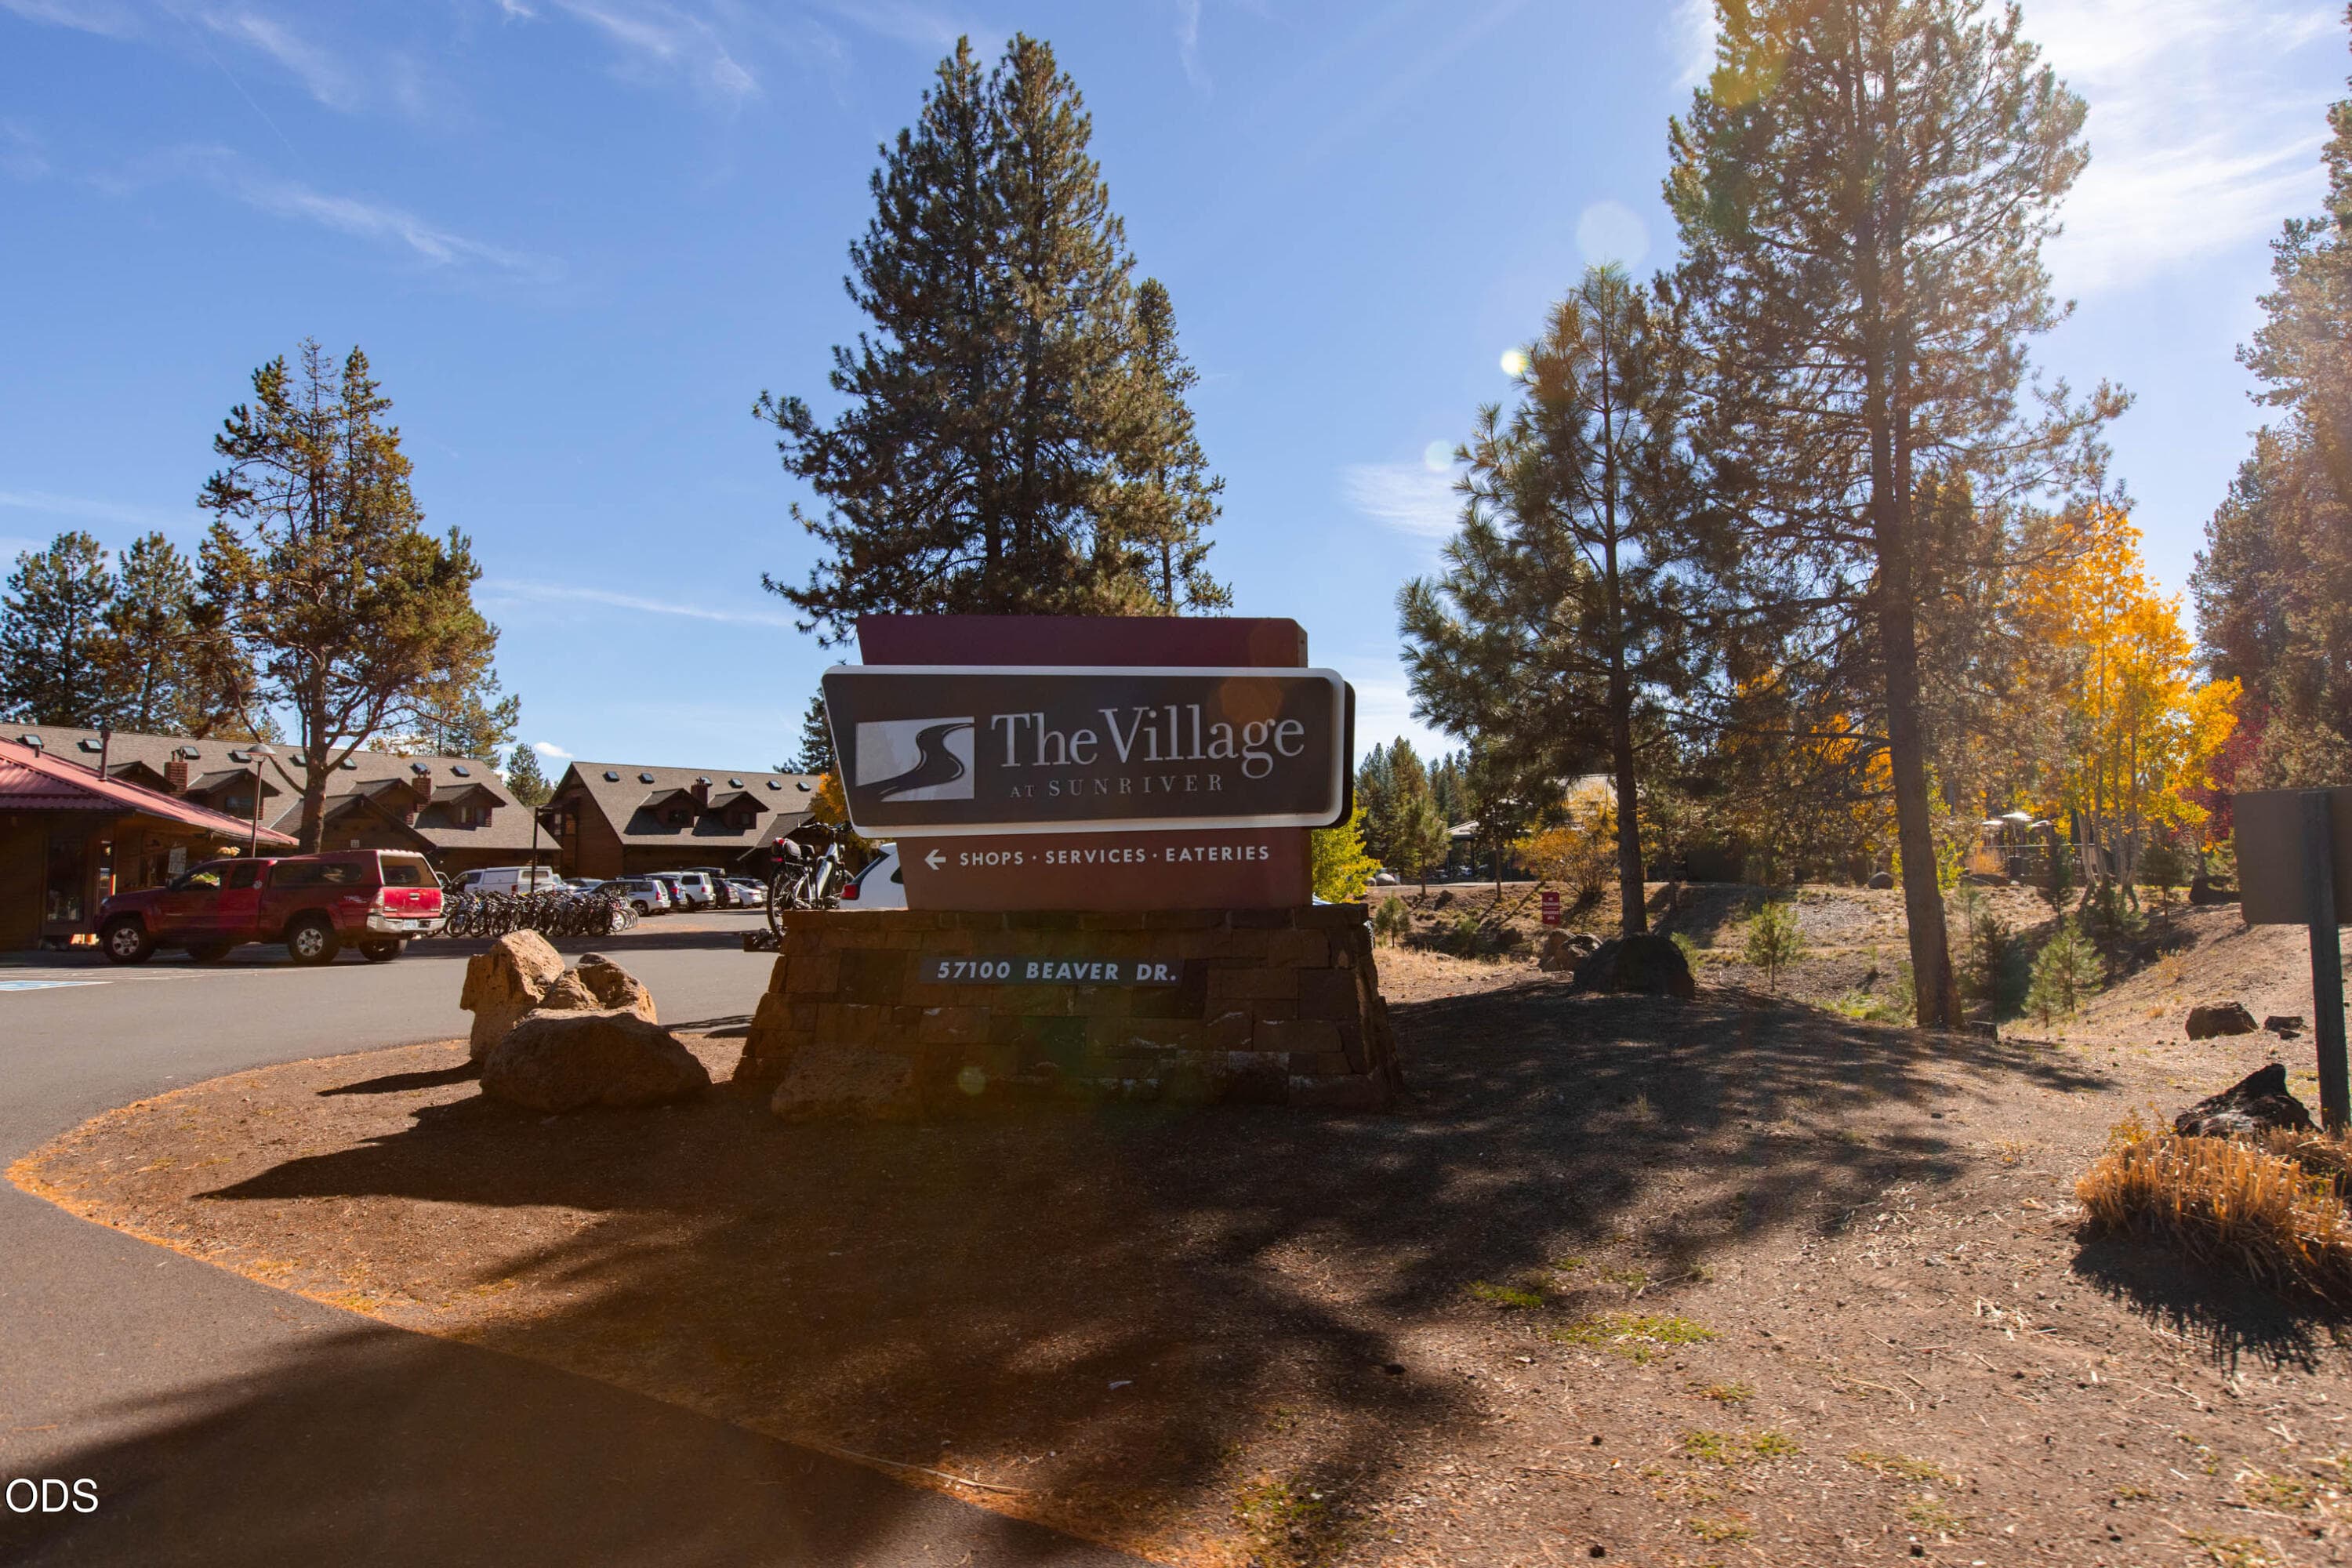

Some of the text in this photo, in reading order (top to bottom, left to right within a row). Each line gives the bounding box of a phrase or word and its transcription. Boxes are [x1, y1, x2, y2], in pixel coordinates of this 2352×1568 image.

[991, 704, 1305, 779] The Village
[1009, 774, 1223, 798] AT SUNRIVER
[960, 845, 1269, 866] SHOPS SERVICES EATERIES
[937, 961, 1176, 981] 57100 BEAVER DR.
